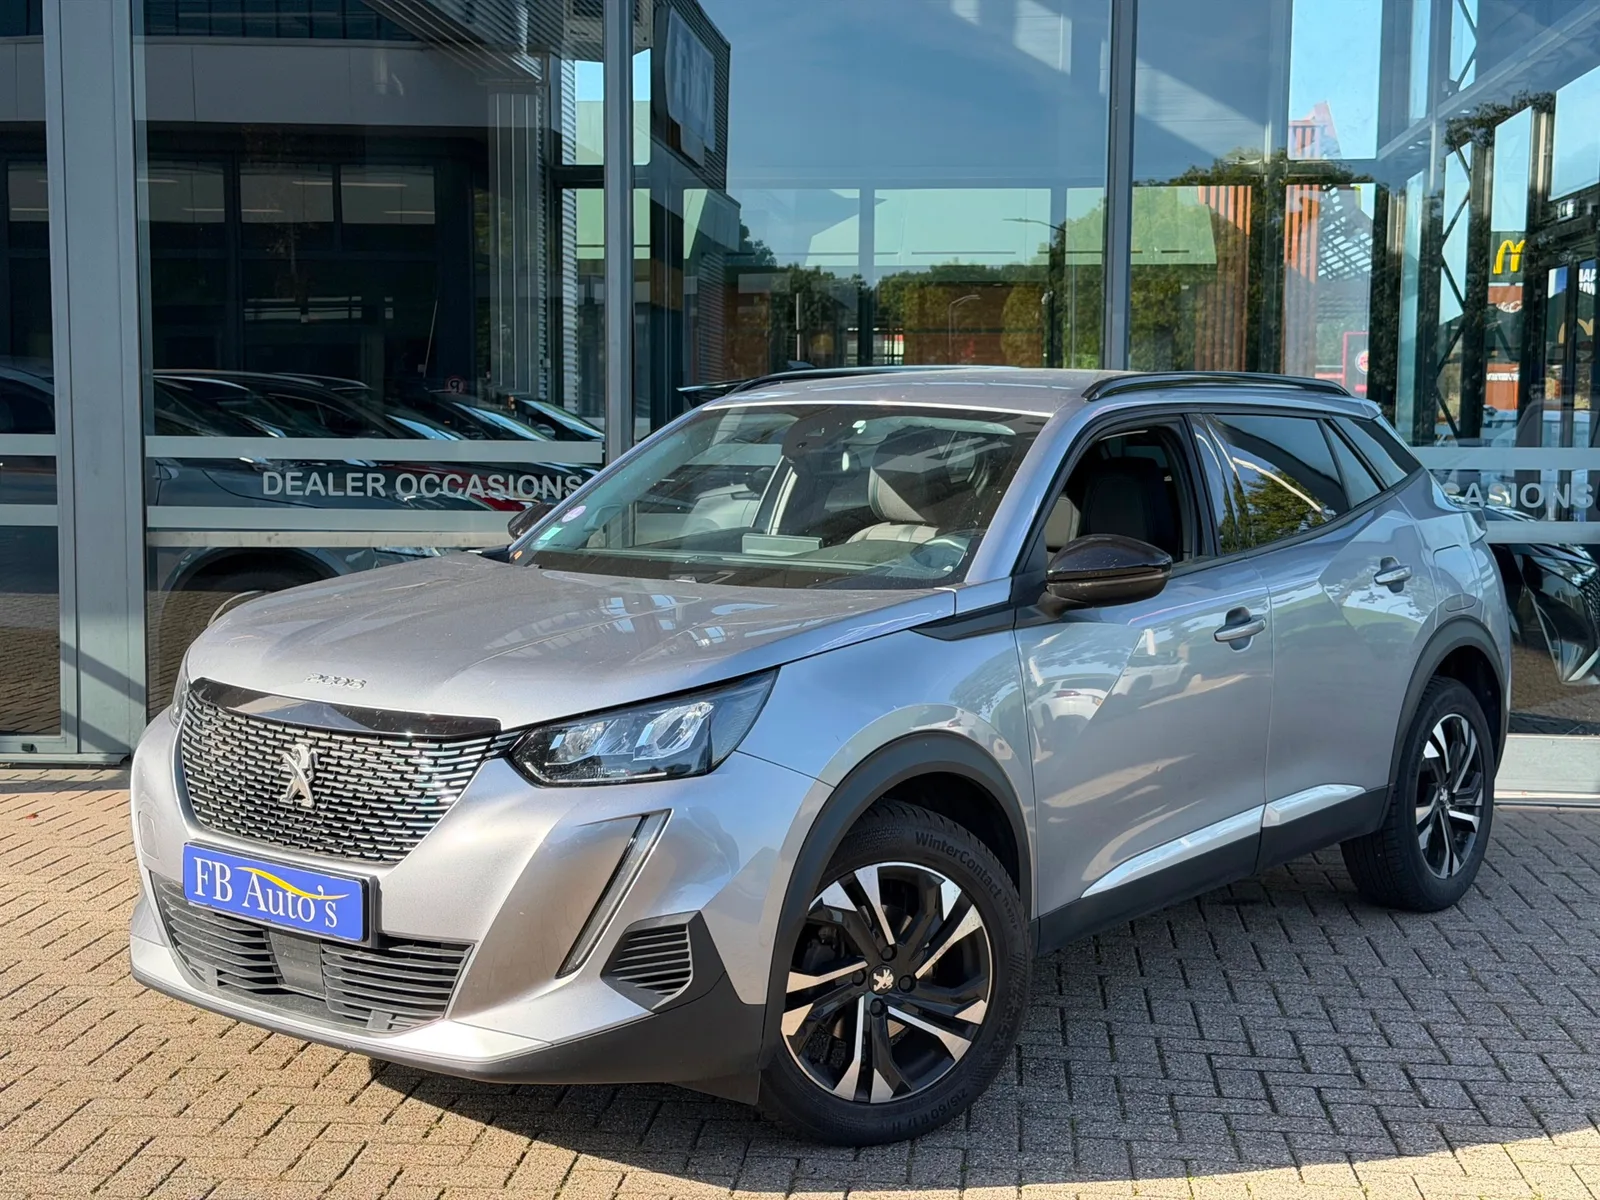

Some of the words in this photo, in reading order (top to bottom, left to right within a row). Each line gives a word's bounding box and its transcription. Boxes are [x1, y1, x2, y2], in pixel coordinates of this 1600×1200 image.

[262, 471, 386, 497] DEALER
[395, 472, 583, 500] OCCASIONS
[193, 857, 232, 902] FB
[241, 872, 338, 929] Auto's
[915, 831, 1003, 899] WinterContact
